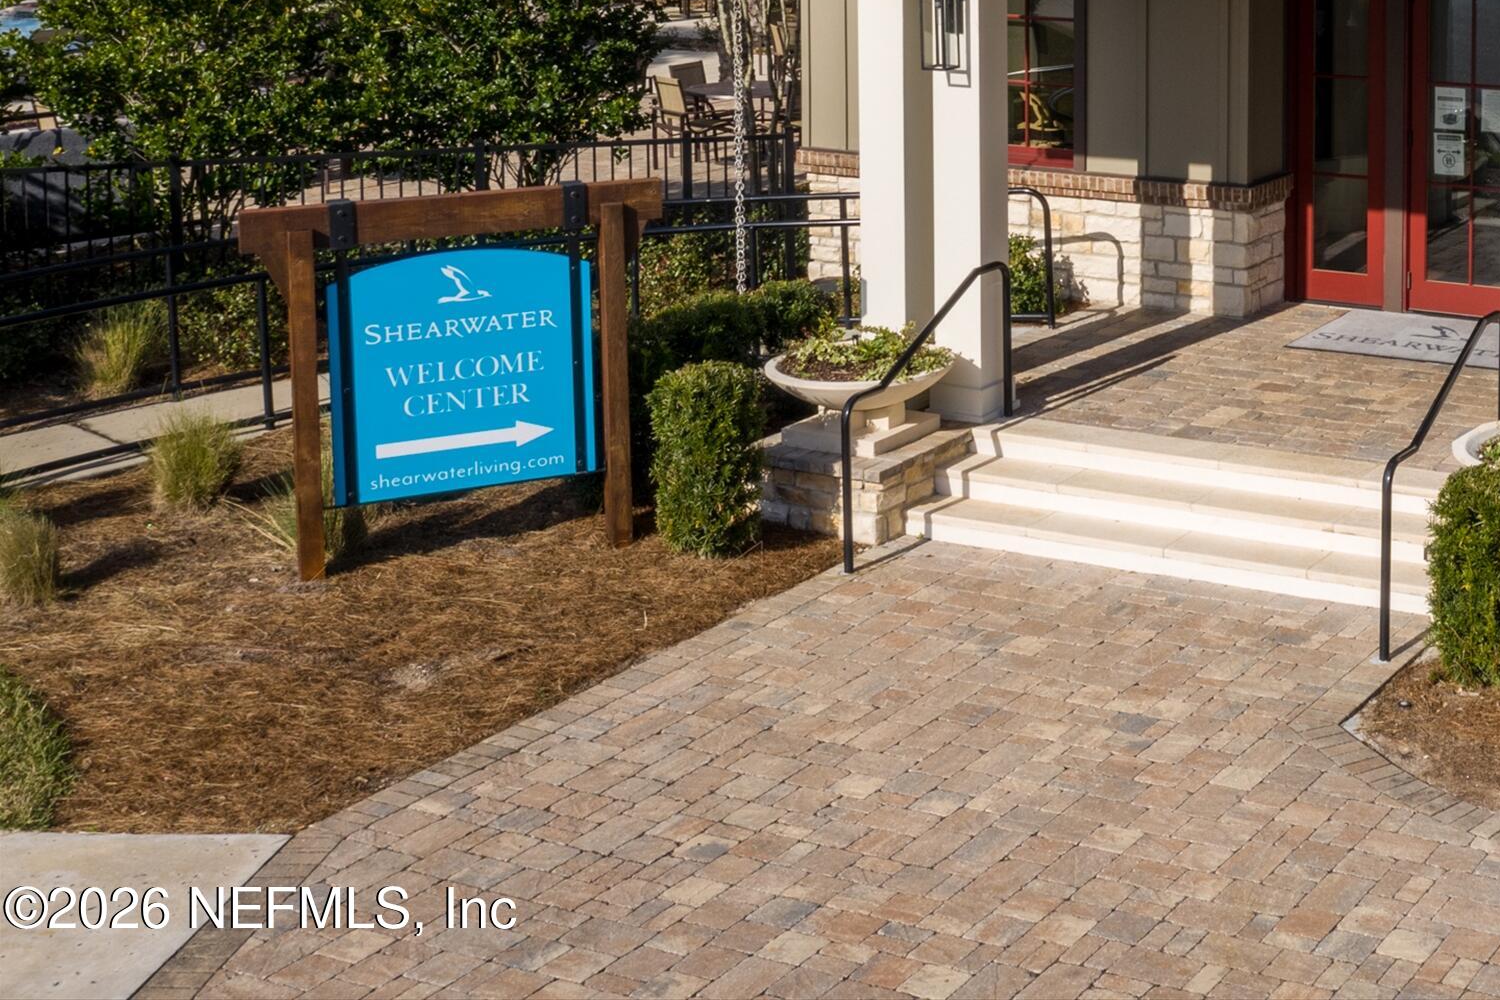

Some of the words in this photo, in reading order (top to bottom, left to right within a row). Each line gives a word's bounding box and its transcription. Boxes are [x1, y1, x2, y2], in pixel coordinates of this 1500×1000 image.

[365, 309, 557, 345] SHEARWATER
[386, 350, 544, 387] WELCOME
[403, 383, 530, 417] CENTER
[370, 454, 565, 490] shearwaterliving.com
